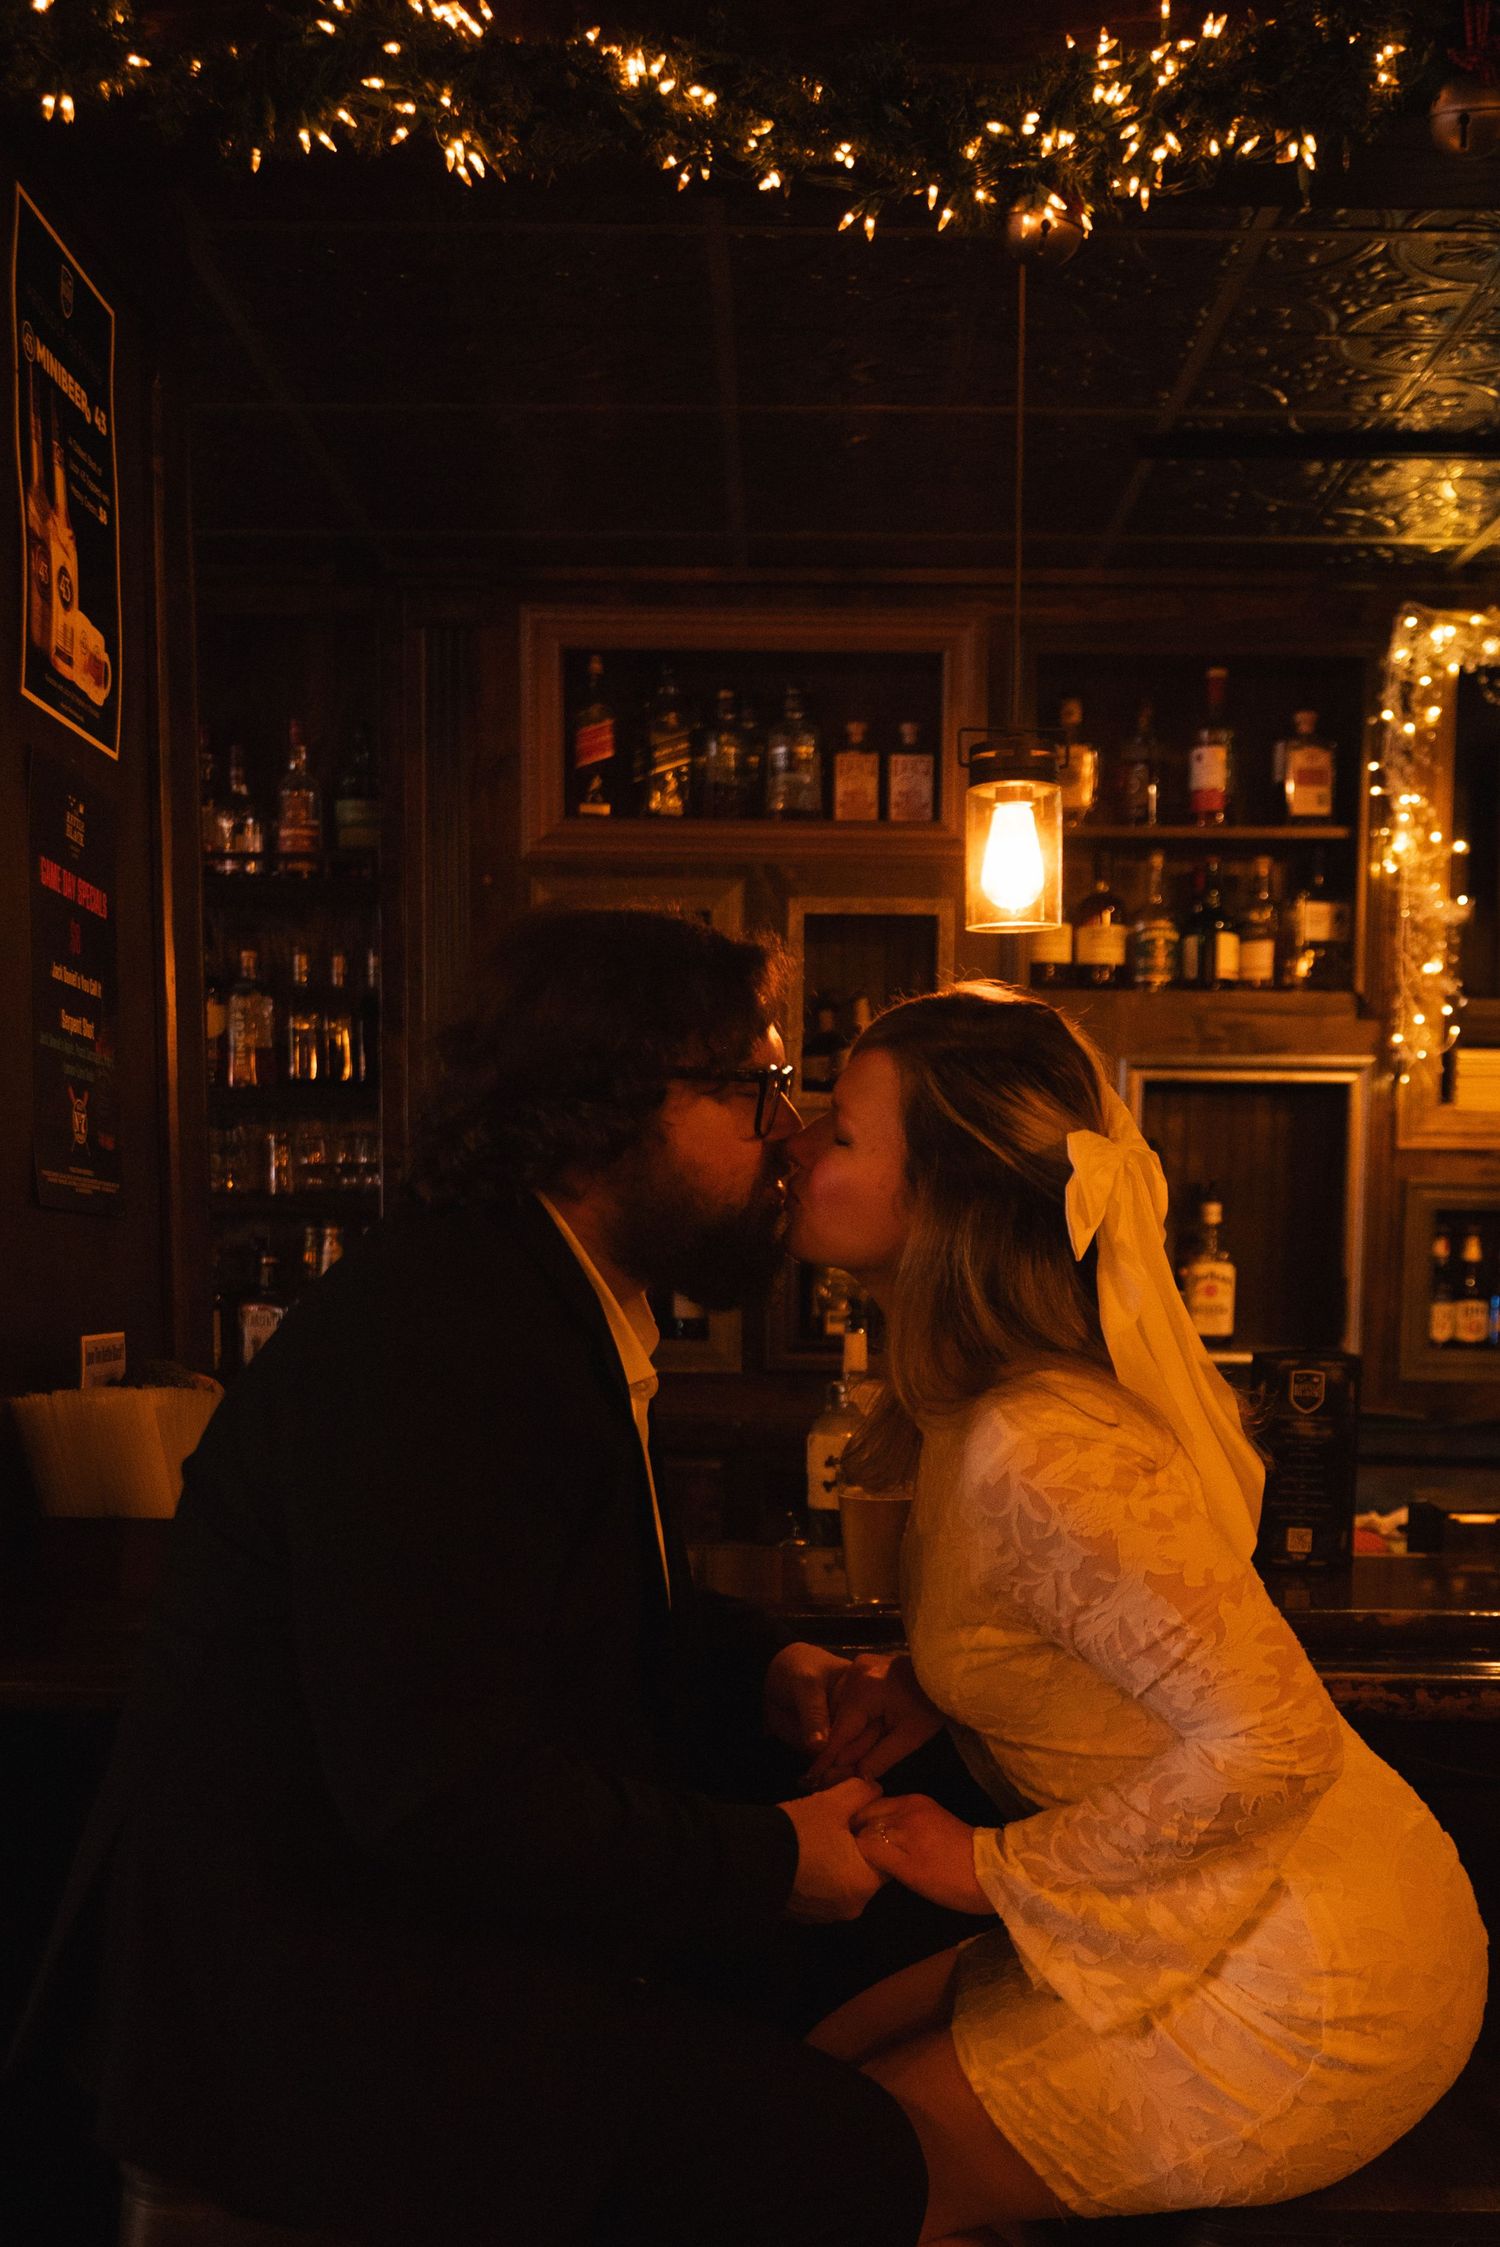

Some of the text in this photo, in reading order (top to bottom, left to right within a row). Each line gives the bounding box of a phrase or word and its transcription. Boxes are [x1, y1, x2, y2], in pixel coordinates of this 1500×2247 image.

[95, 405, 107, 436] 43
[60, 573, 70, 602] 43
[40, 855, 108, 920] GAME DAY SPECIALS
